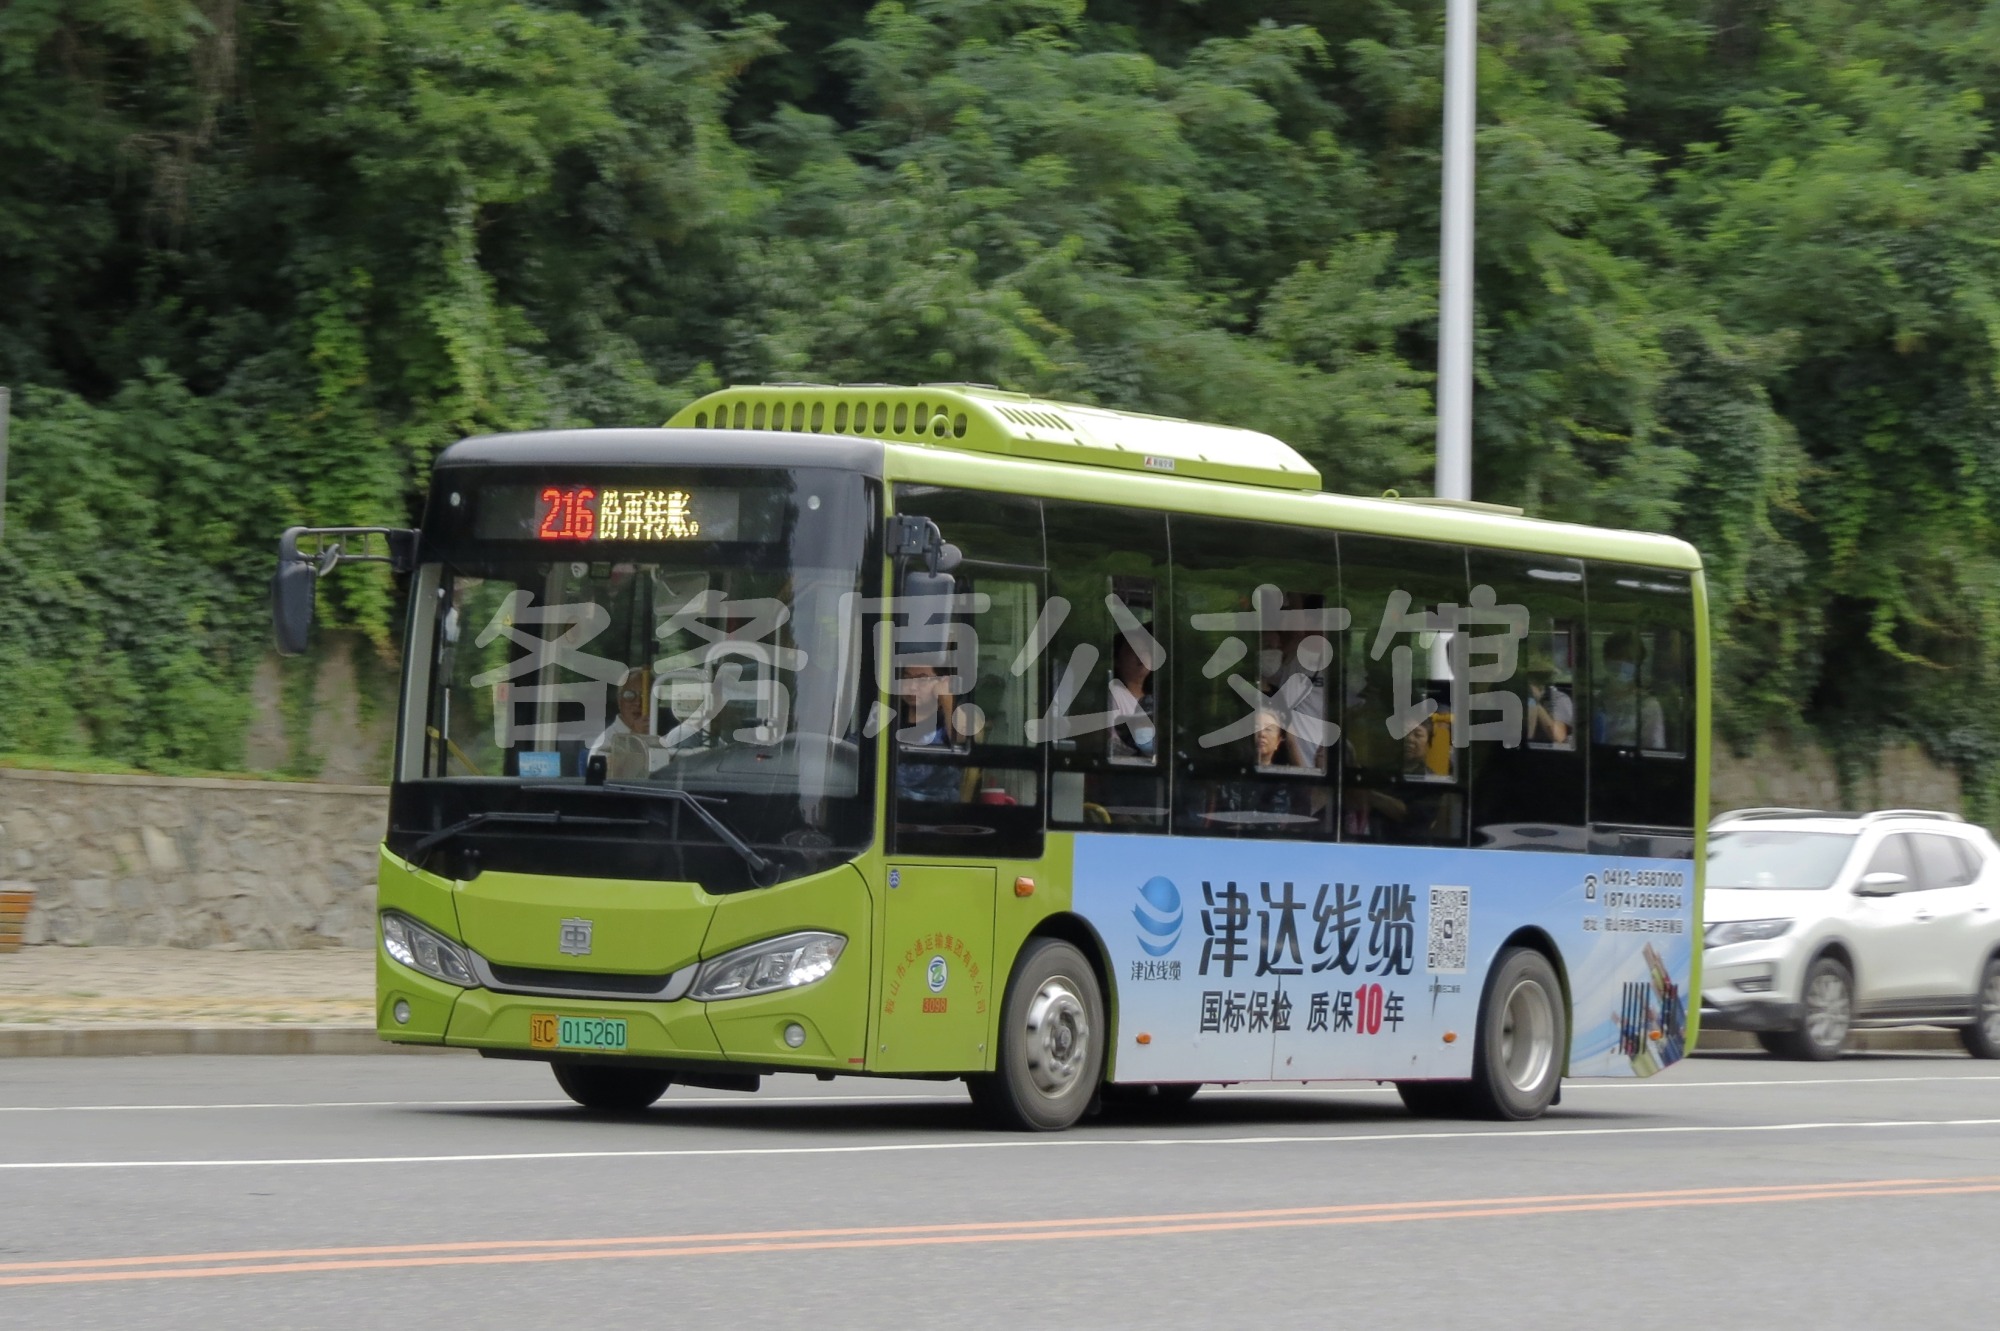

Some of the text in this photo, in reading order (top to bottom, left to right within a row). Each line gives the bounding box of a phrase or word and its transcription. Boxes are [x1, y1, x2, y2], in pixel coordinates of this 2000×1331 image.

[540, 488, 595, 540] 216
[1603, 869, 1683, 888] 0412-8587000
[1603, 892, 1682, 909] 18741266664
[1199, 881, 1417, 977] 津达线缆
[884, 932, 986, 1014] 鞍山市交通运输集团有限公司
[1131, 960, 1182, 981] 津达线缆
[923, 998, 947, 1013] 3098
[1200, 983, 1405, 1035] 国标保检 质保10年
